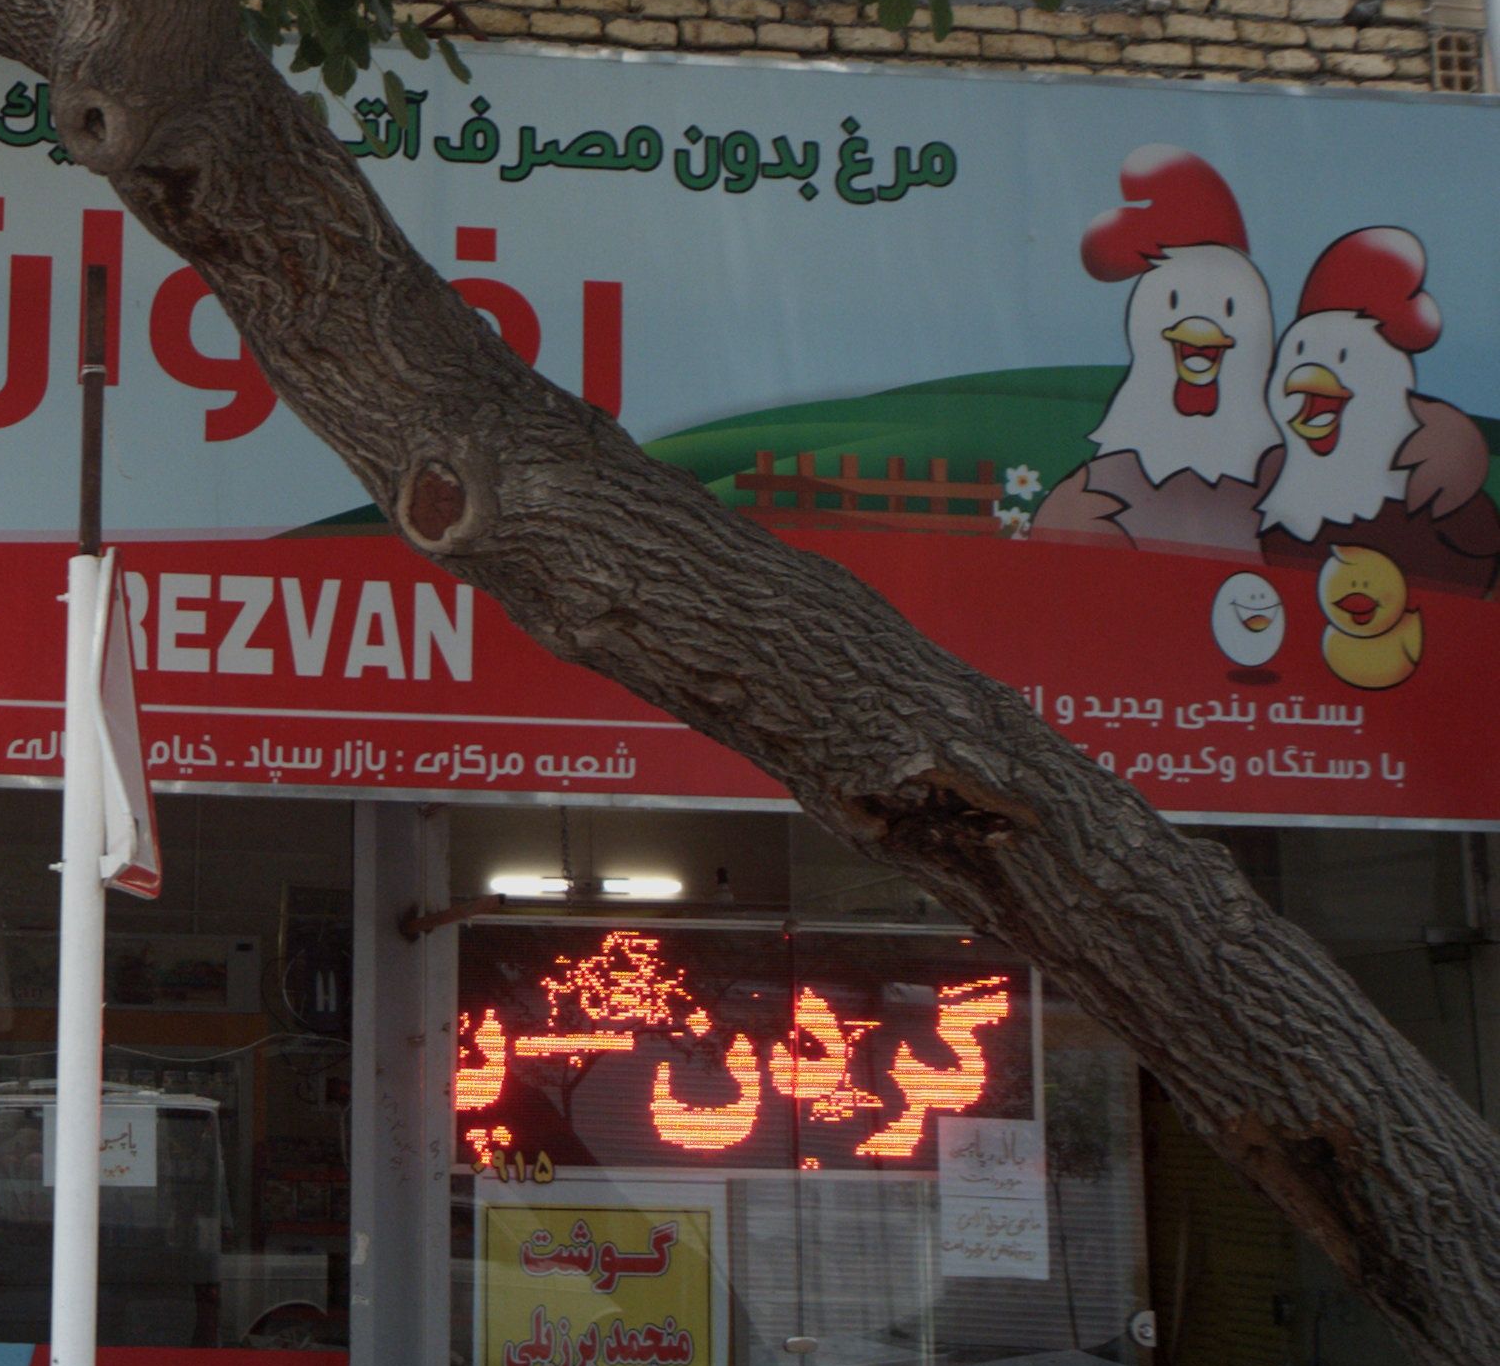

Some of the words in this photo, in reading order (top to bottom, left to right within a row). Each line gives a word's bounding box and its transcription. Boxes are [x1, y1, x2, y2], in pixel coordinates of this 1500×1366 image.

[434, 94, 664, 182] مصرف
[674, 125, 820, 202] بدون
[834, 115, 958, 204] مرغ
[1056, 693, 1075, 724] و
[1083, 692, 1164, 728] جدید
[1175, 693, 1256, 729] بندی
[1268, 694, 1364, 734] بسته
[147, 735, 218, 774] خیام
[243, 739, 323, 784] سپاد
[331, 739, 387, 780] بازار
[414, 744, 525, 781] مرکزی
[535, 742, 636, 785] شعبه
[1125, 745, 1237, 783] وکیوم
[1246, 745, 1371, 780] دستگاه
[1381, 752, 1407, 787] با
[521, 1221, 678, 1291] گوشت
